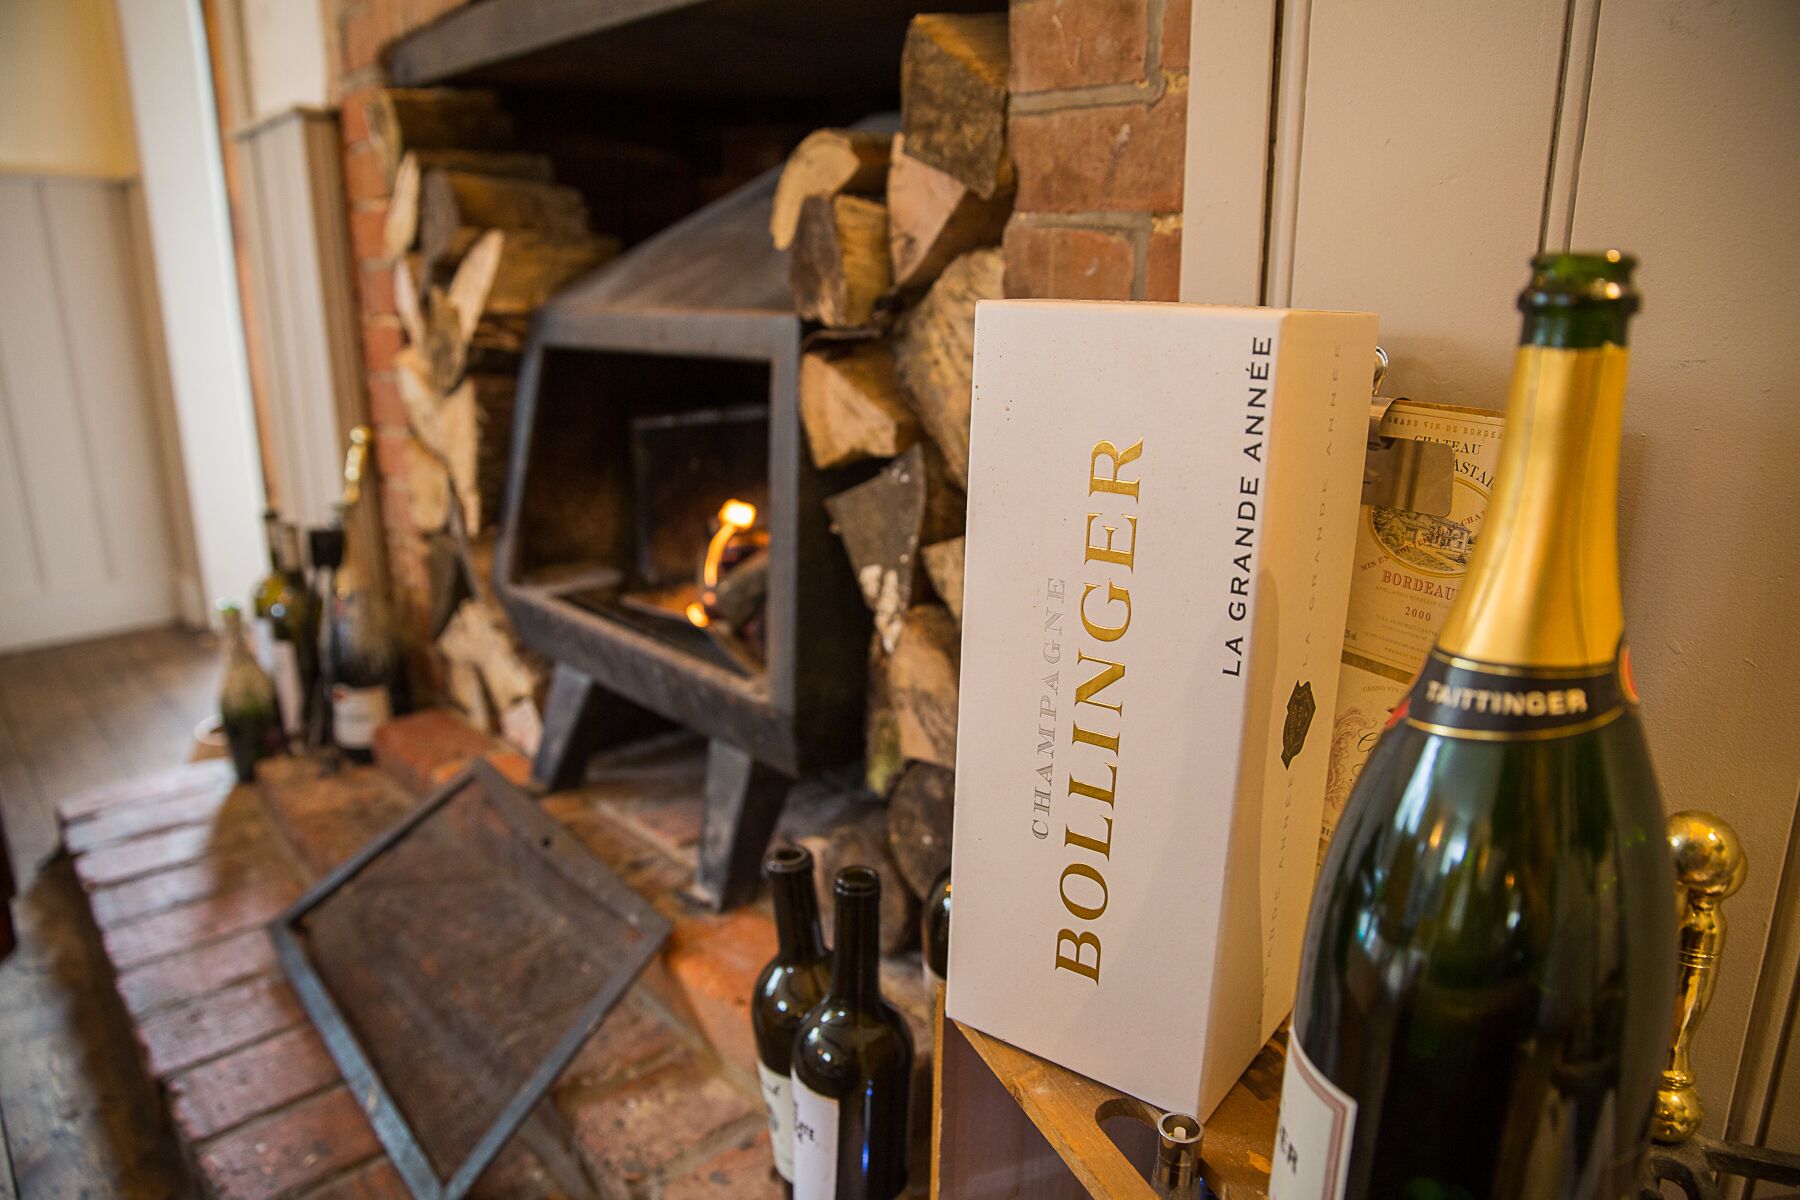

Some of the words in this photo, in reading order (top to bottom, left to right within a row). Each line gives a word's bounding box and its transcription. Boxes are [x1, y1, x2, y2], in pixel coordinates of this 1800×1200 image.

[1243, 336, 1272, 462] ANNÉE
[1387, 417, 1418, 427] GRAND
[1424, 421, 1441, 430] VIN
[1446, 425, 1457, 433] DE
[1463, 428, 1503, 440] BORDEA
[1228, 476, 1260, 621] GRANDE
[1382, 569, 1456, 601] BORDEAU
[1222, 635, 1244, 677] LA
[1405, 606, 1432, 622] 2000
[1031, 577, 1066, 840] CHAMPAGNE
[1055, 433, 1144, 987] BOLLINGER
